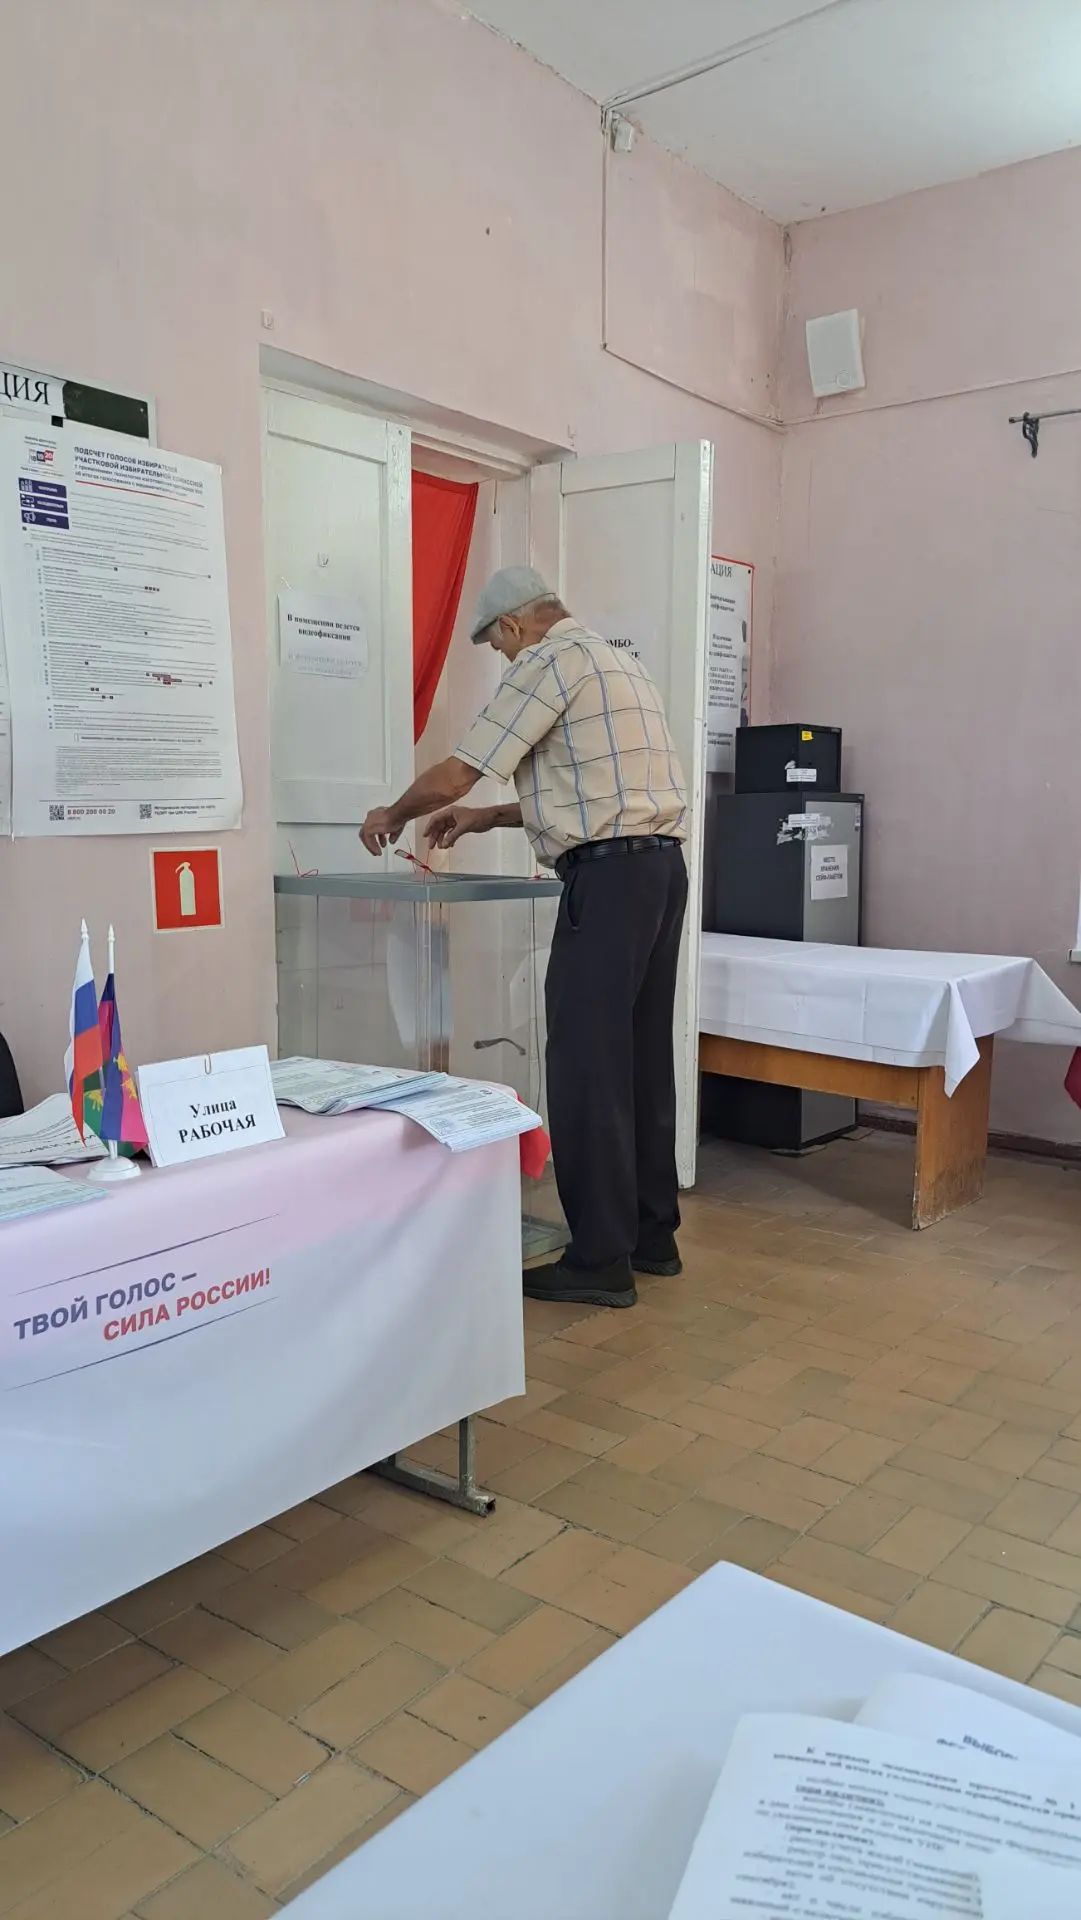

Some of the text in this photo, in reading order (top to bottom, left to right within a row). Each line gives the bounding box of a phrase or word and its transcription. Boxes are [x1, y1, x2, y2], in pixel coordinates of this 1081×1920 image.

[74, 446, 105, 458] ПОДСЧЕТ
[106, 453, 136, 464] ГОЛОСОВ
[74, 456, 119, 470] УЧАСТКОВОЙ
[711, 563, 732, 578] АЦИЯ
[605, 638, 634, 648] МБО-
[189, 1099, 237, 1119] Улица
[178, 1114, 256, 1144] РАБОЧАЯ
[13, 1295, 88, 1340] ТВОЙ
[96, 1272, 176, 1316] ГОЛОС
[103, 1267, 271, 1341] СИЛА РОССИИ!
